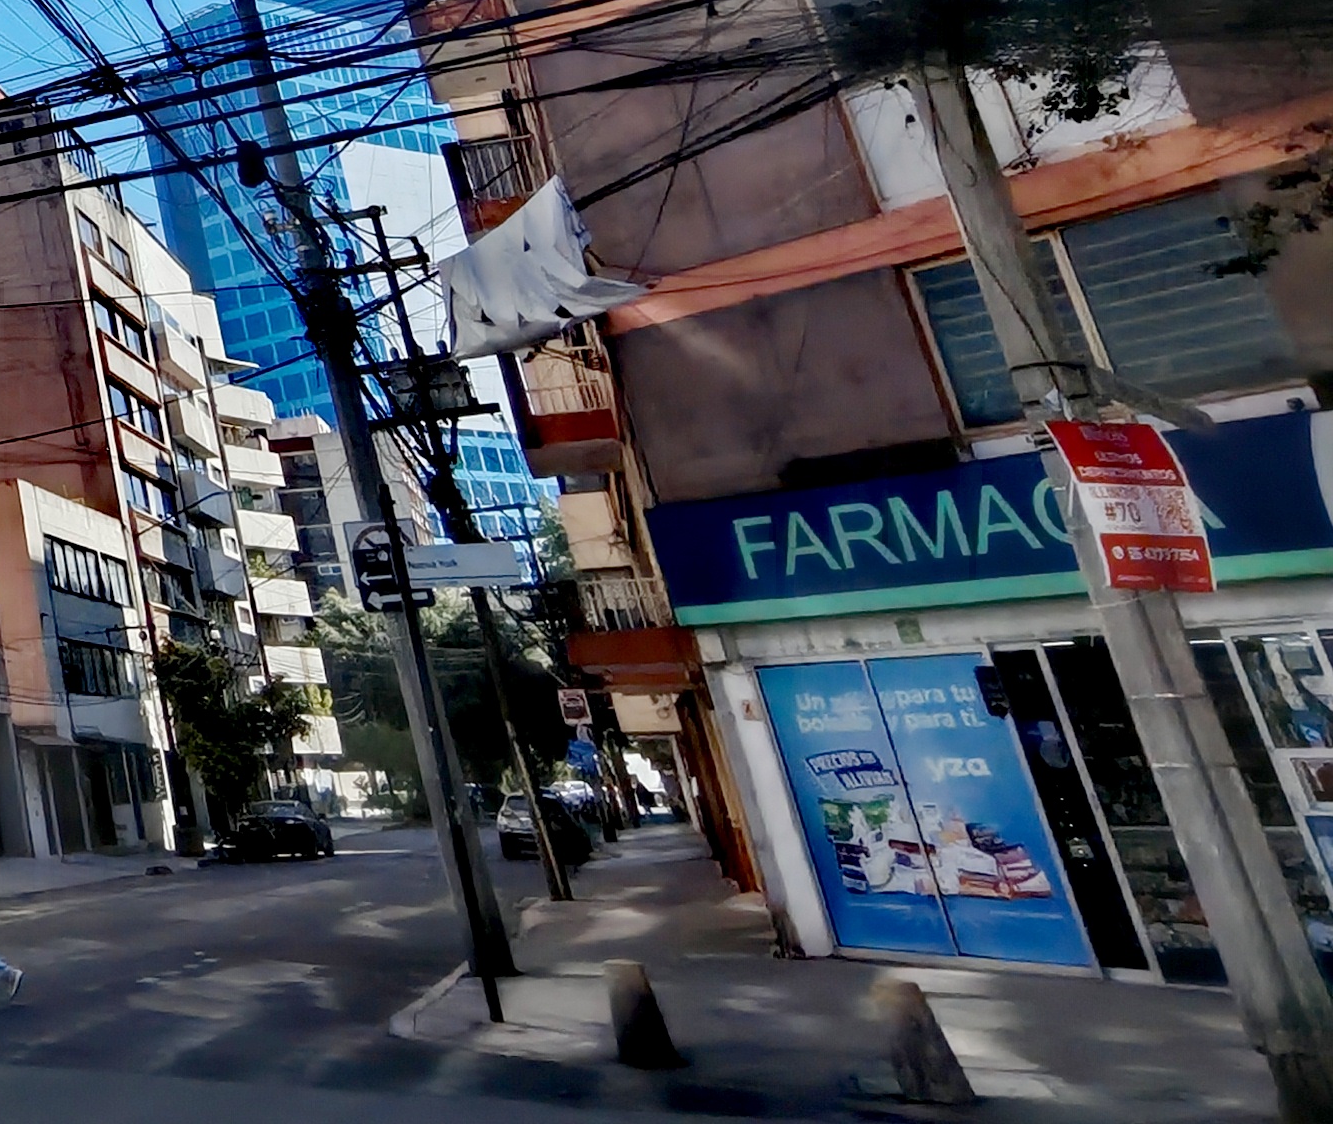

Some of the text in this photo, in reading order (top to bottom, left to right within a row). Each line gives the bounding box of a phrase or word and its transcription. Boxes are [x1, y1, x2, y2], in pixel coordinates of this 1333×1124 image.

[733, 477, 1225, 580] FARMAC
[894, 687, 946, 710] para
[950, 684, 976, 704] tu
[904, 712, 957, 733] para
[925, 756, 992, 783] yza
